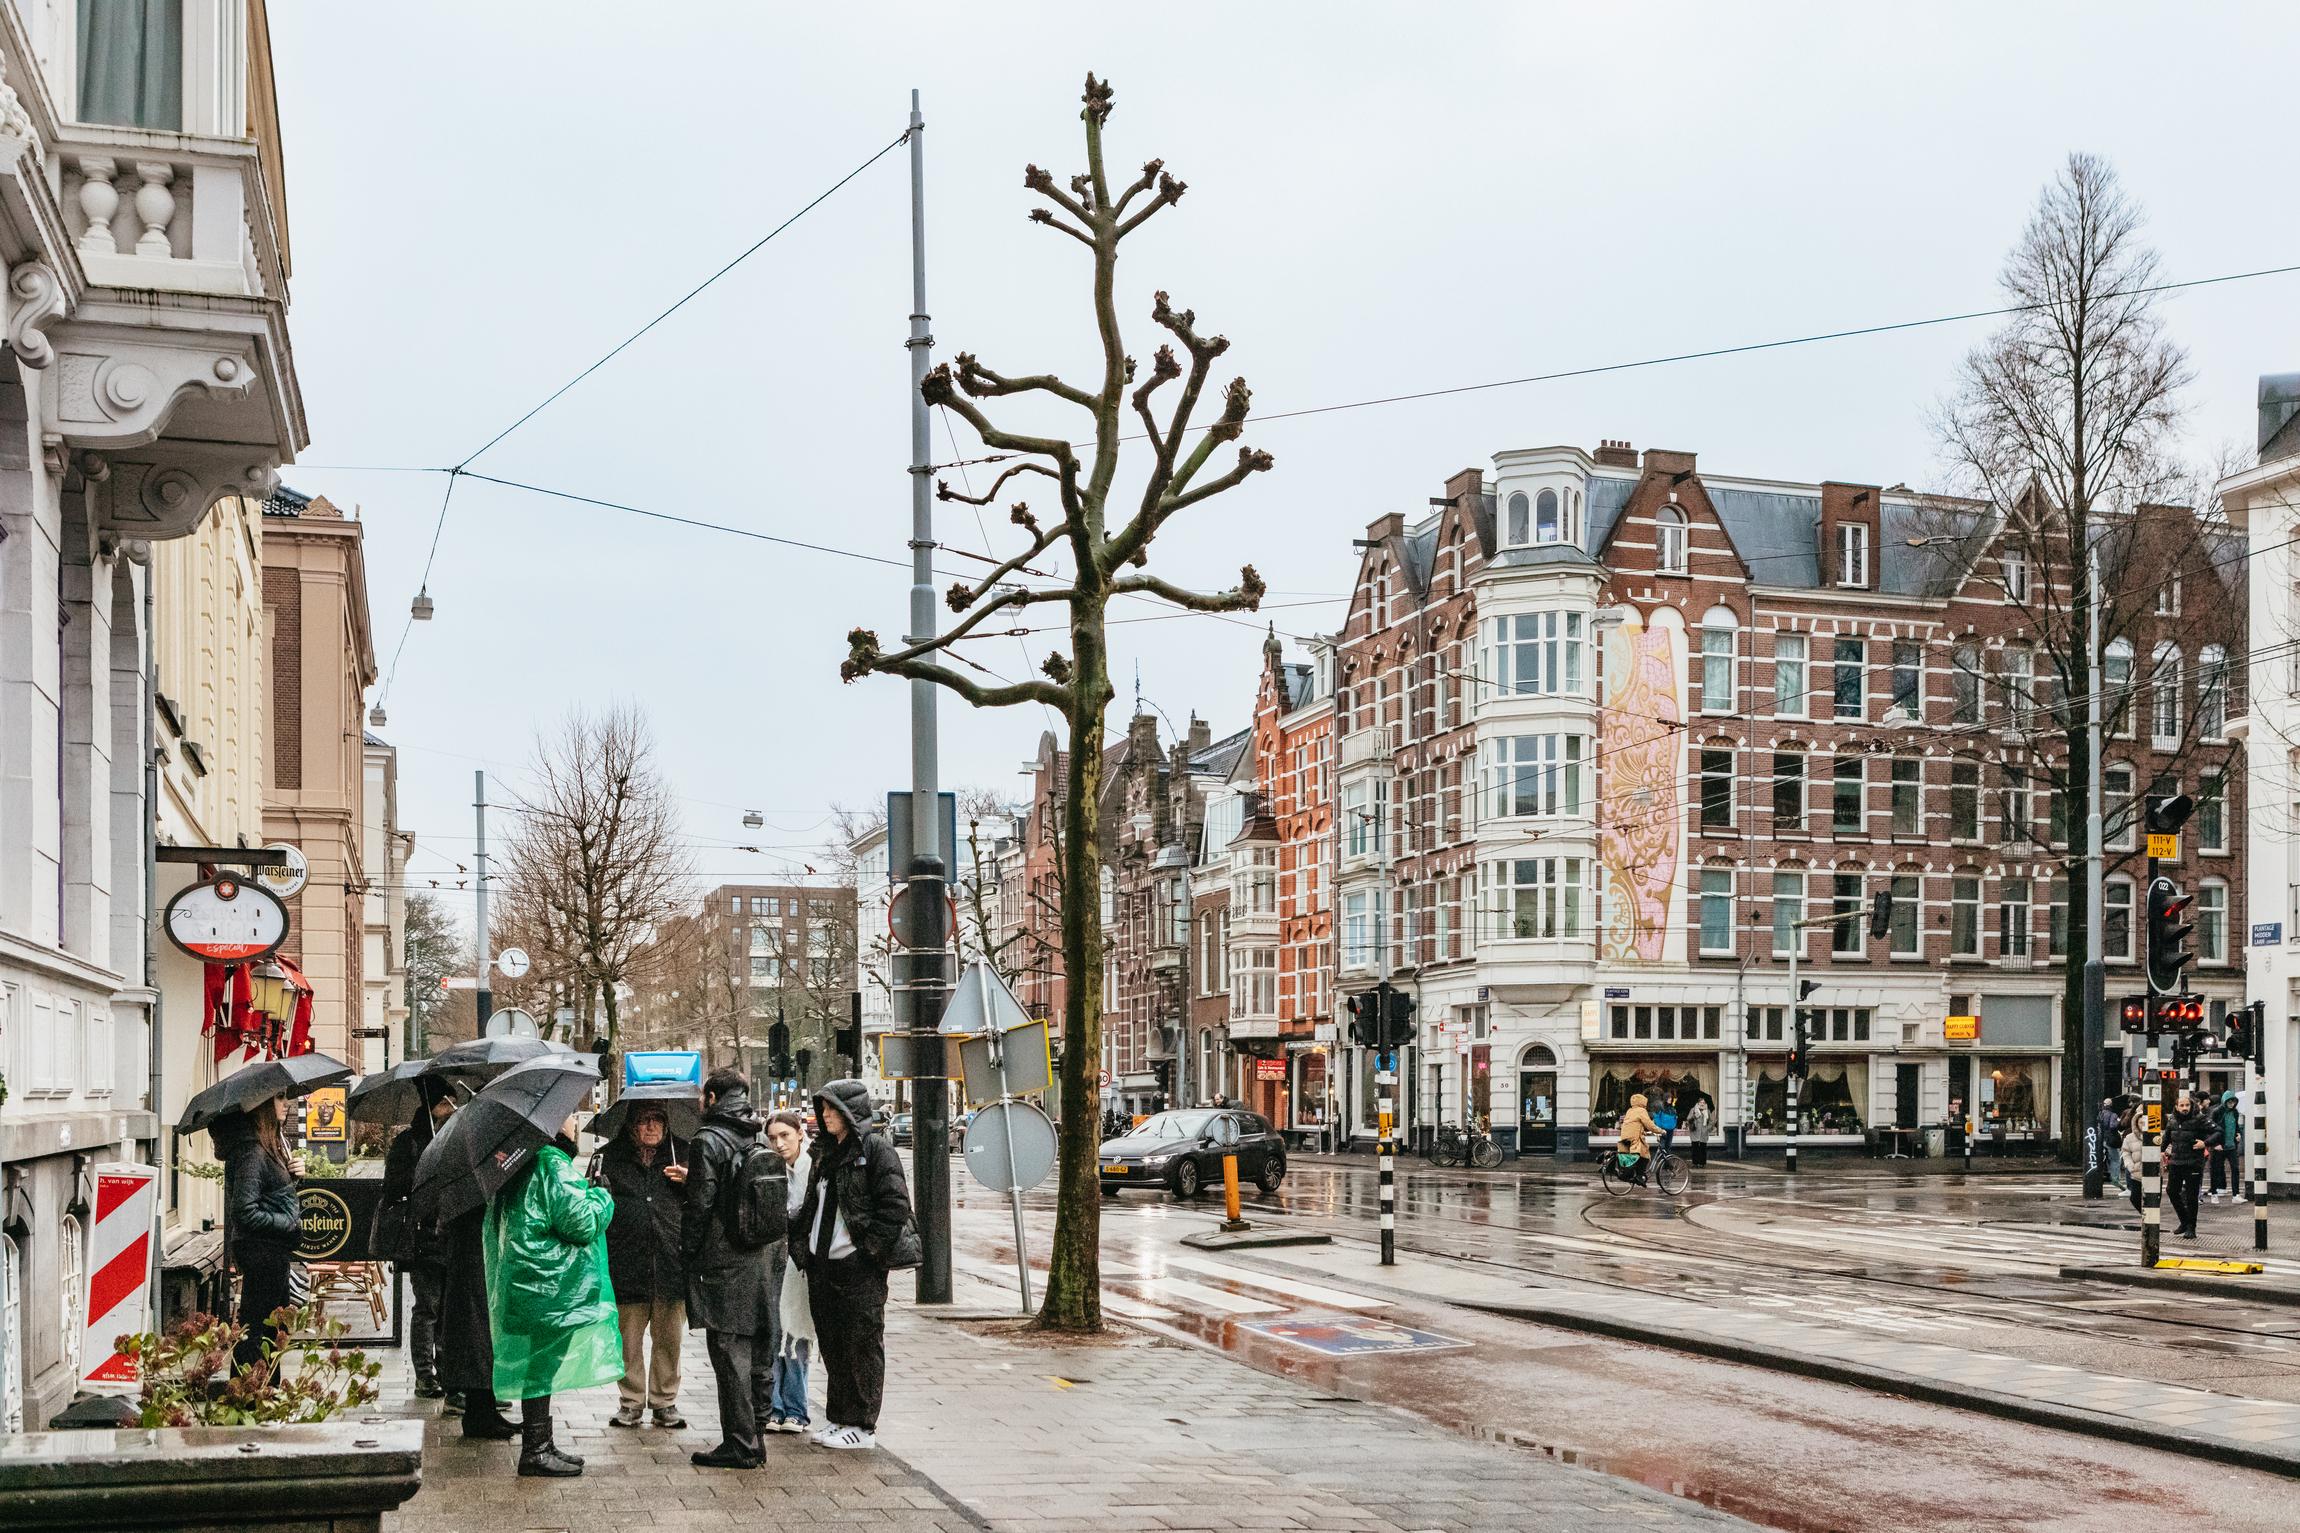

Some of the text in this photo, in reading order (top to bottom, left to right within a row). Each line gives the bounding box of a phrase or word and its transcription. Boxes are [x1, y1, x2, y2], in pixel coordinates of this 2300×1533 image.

[2153, 836, 2171, 844] 111-V
[2152, 847, 2172, 856] 112-V
[2158, 881, 2169, 891] 022
[299, 1212, 345, 1233] rsteiner
